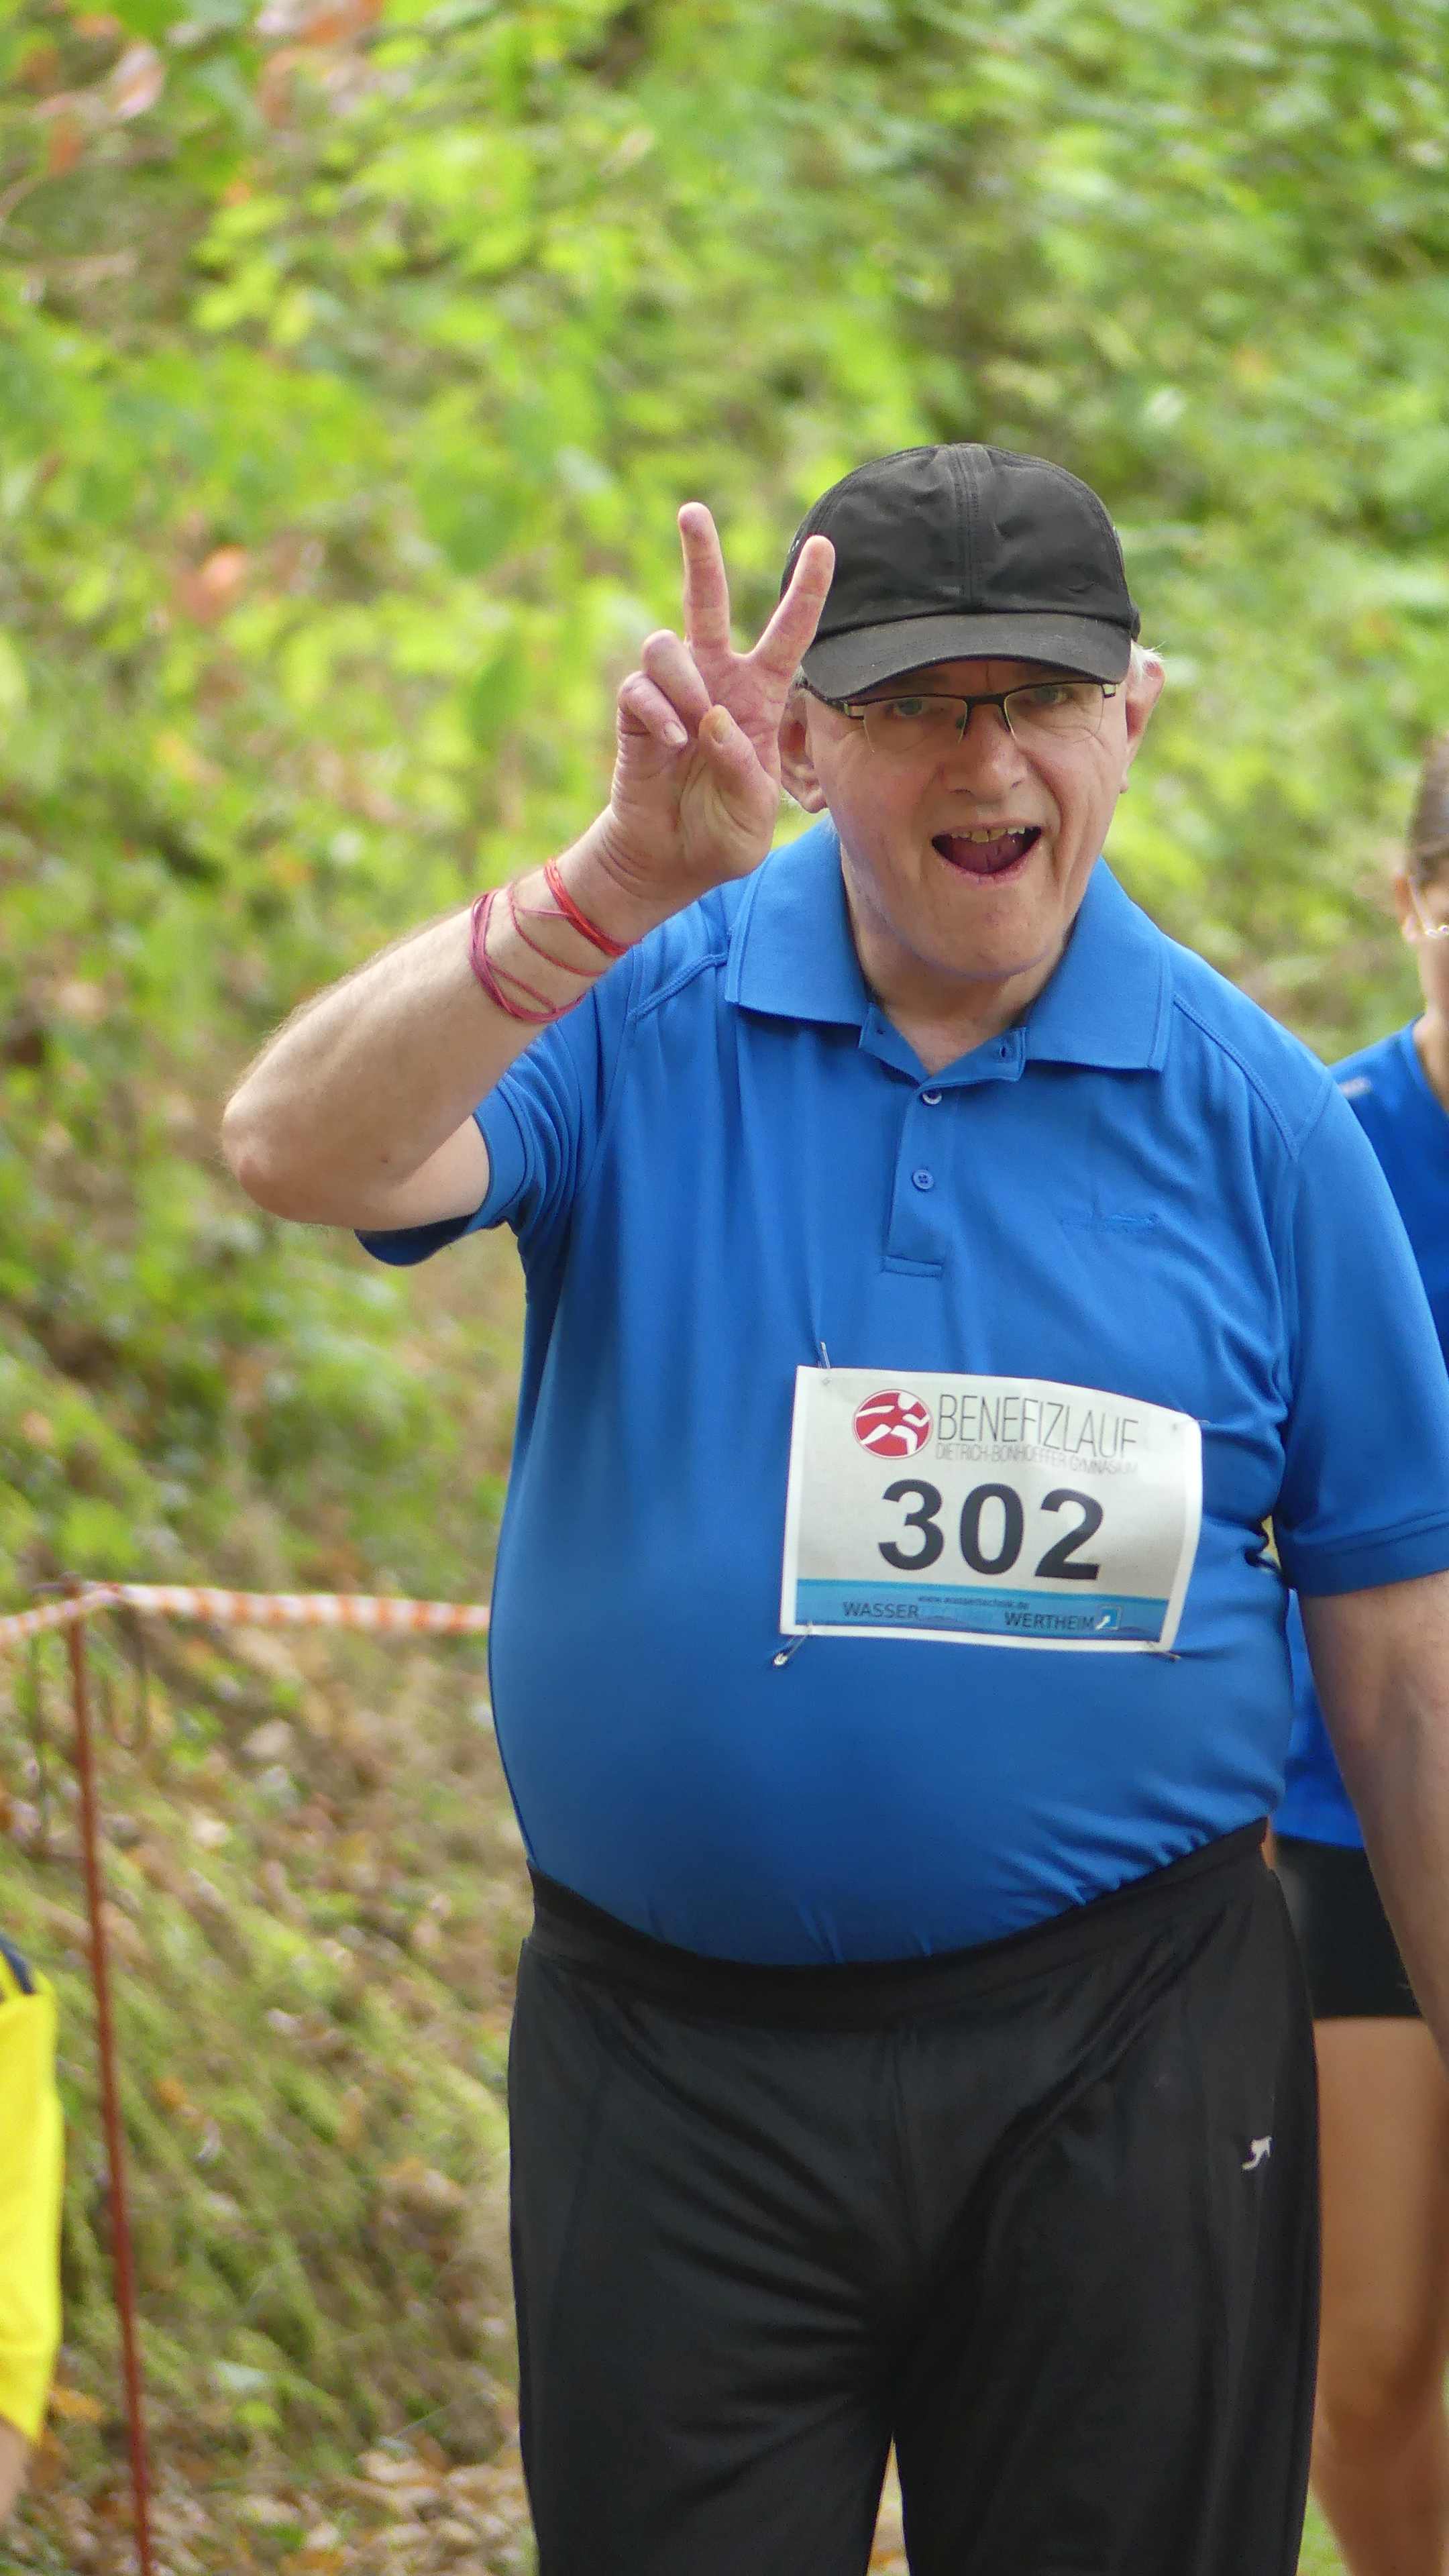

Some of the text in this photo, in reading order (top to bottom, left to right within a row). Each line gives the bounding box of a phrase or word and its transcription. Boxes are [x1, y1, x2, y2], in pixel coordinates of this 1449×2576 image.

[937, 1394, 1138, 1458] BENEFIZLAUF
[878, 1479, 1104, 1580] 302
[843, 1601, 919, 1618] WASSER
[1005, 1612, 1095, 1631] WERTHEIM
